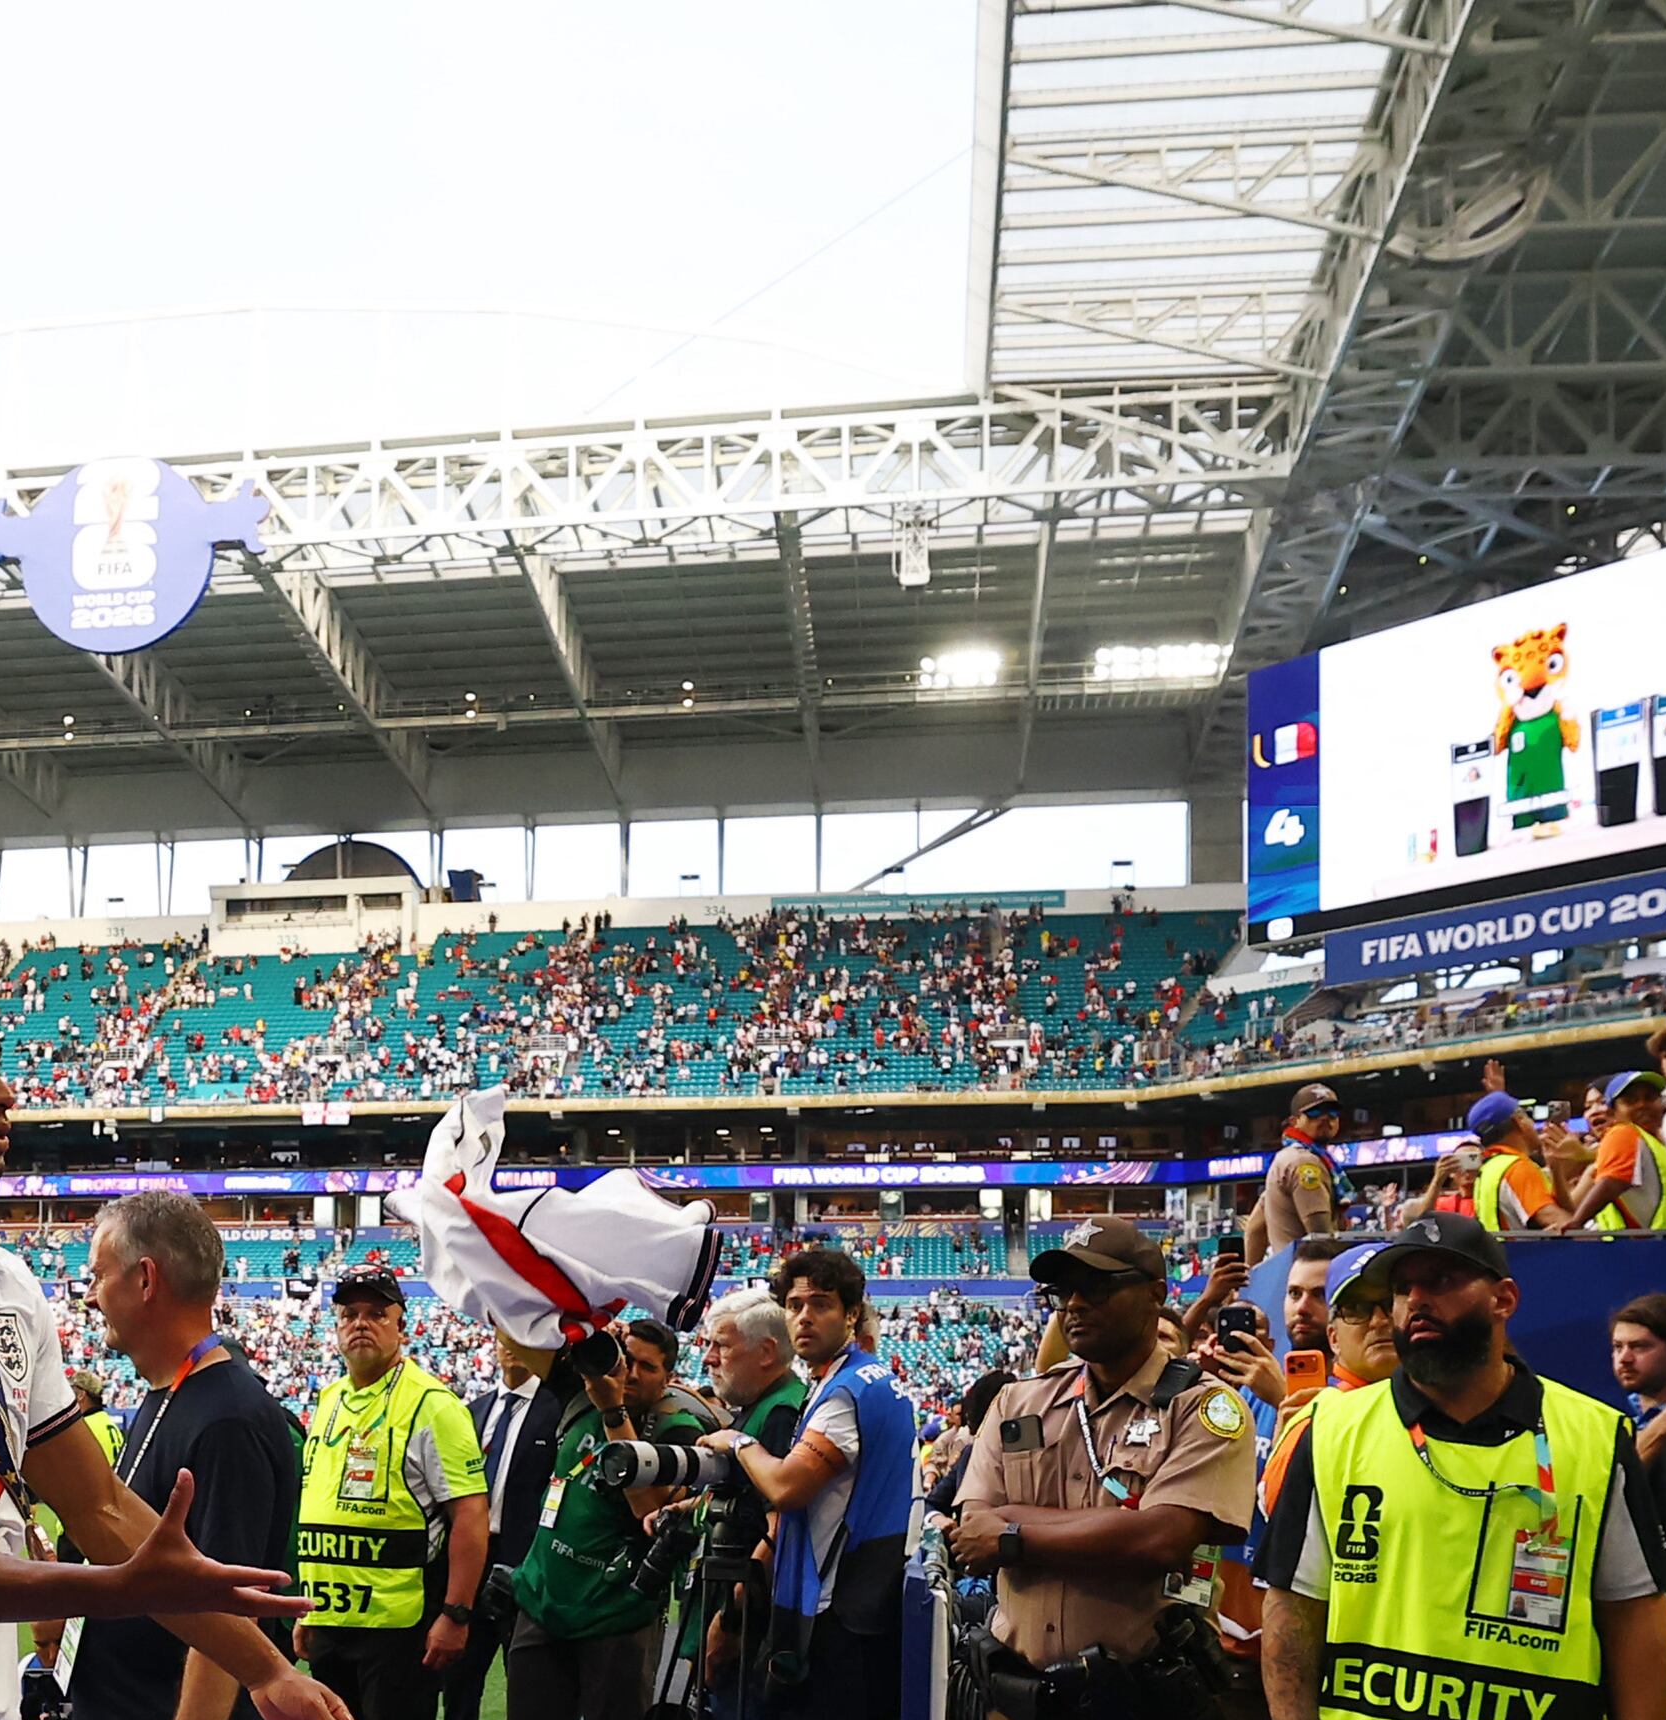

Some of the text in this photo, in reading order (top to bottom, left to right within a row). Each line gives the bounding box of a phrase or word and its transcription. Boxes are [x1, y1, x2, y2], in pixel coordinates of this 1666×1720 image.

[97, 563, 133, 576] FIFA
[71, 590, 156, 607] WORLD CUP
[70, 604, 156, 630] 2026
[1264, 808, 1305, 847] 4
[1360, 935, 1424, 966] FIFA
[1426, 913, 1535, 954] WORLD
[1538, 900, 1606, 938] CUP
[772, 1167, 813, 1184] FIFA
[814, 1166, 879, 1184] WORLD
[880, 1166, 918, 1183] CUP
[1208, 1157, 1264, 1177] MIAMI
[69, 1177, 189, 1192] BRONZE FINAL
[495, 1171, 558, 1187] MIAMI
[242, 1229, 270, 1241] CUP
[335, 1501, 386, 1516] FIFA.com
[551, 1539, 606, 1571] FIFA.com
[1346, 1544, 1367, 1554] FIFA
[1361, 1563, 1378, 1571] CUP
[1334, 1570, 1378, 1583] 2026
[1464, 1620, 1561, 1652] FIFA.com
